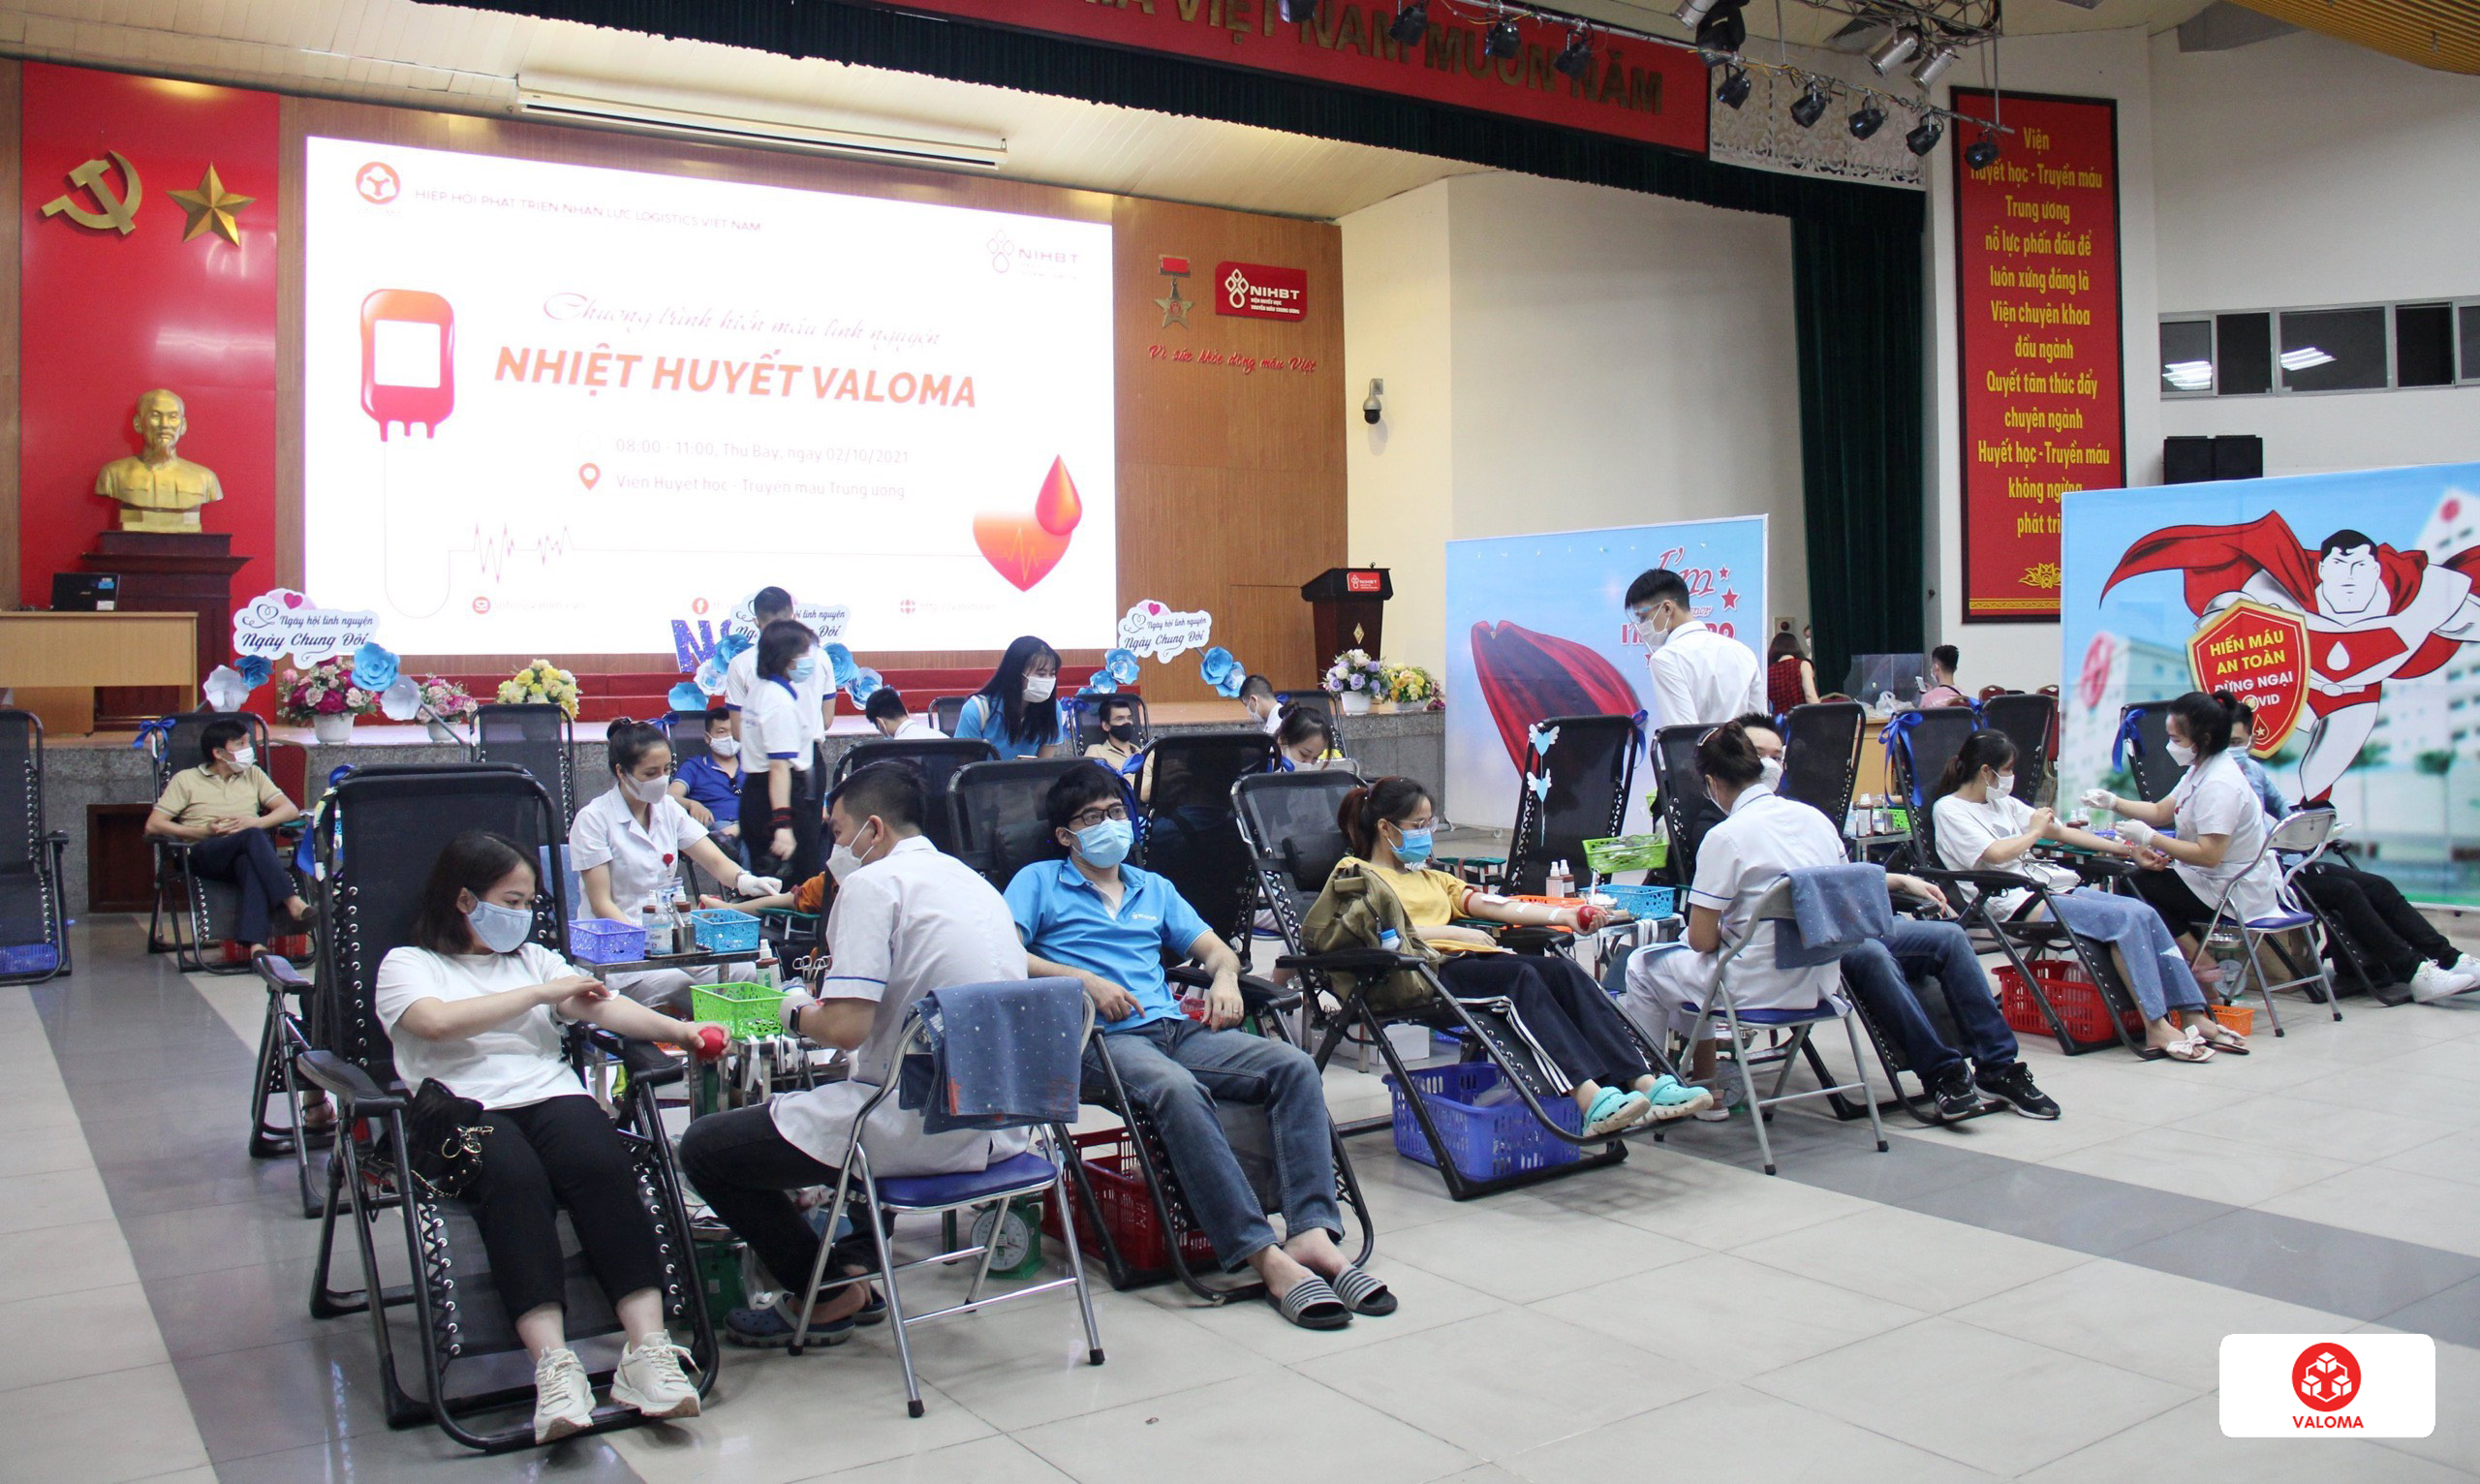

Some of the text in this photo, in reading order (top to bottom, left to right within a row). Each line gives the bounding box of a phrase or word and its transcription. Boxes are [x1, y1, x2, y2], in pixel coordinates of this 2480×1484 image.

[2023, 127, 2050, 154] Viện
[2007, 161, 2029, 188] học
[2036, 163, 2075, 190] Truyền
[2078, 167, 2103, 189] máu
[636, 210, 698, 227] LOGISTICS
[731, 220, 761, 232] NAM
[2005, 196, 2070, 225] Trung ương
[1985, 225, 2092, 258] nỗ lực phấn đấu để
[1018, 248, 1077, 263] NIHBT
[1250, 286, 1300, 300] NIHBT
[1990, 265, 2090, 295] luôn xứng đáng là
[1991, 300, 2091, 329] Viện chuyên khoa
[2015, 333, 2074, 363] đầu ngành
[494, 342, 976, 408] NHIỆT HUYẾT VALOMA
[1987, 367, 2098, 400] Quyết tâm thúc đẩy
[2004, 406, 2083, 433] chuyên ngành
[616, 438, 661, 453] 08:00
[826, 447, 909, 465] 02/10/2021
[1978, 438, 2013, 469] Huyết
[2016, 441, 2036, 469] học
[2044, 439, 2084, 470] Truyền
[2086, 443, 2110, 465] máu
[2008, 477, 2044, 504] không
[2017, 510, 2061, 539] phát tri
[241, 633, 285, 652] Ngày
[291, 633, 337, 654] Chung
[1124, 636, 1152, 652] Ngày
[1156, 633, 1185, 649] Chung
[2210, 629, 2284, 657] HIẾN MÁU
[2216, 649, 2285, 675] AN TOÀN
[2257, 670, 2293, 688] NGẠI
[2238, 694, 2280, 713] OVID
